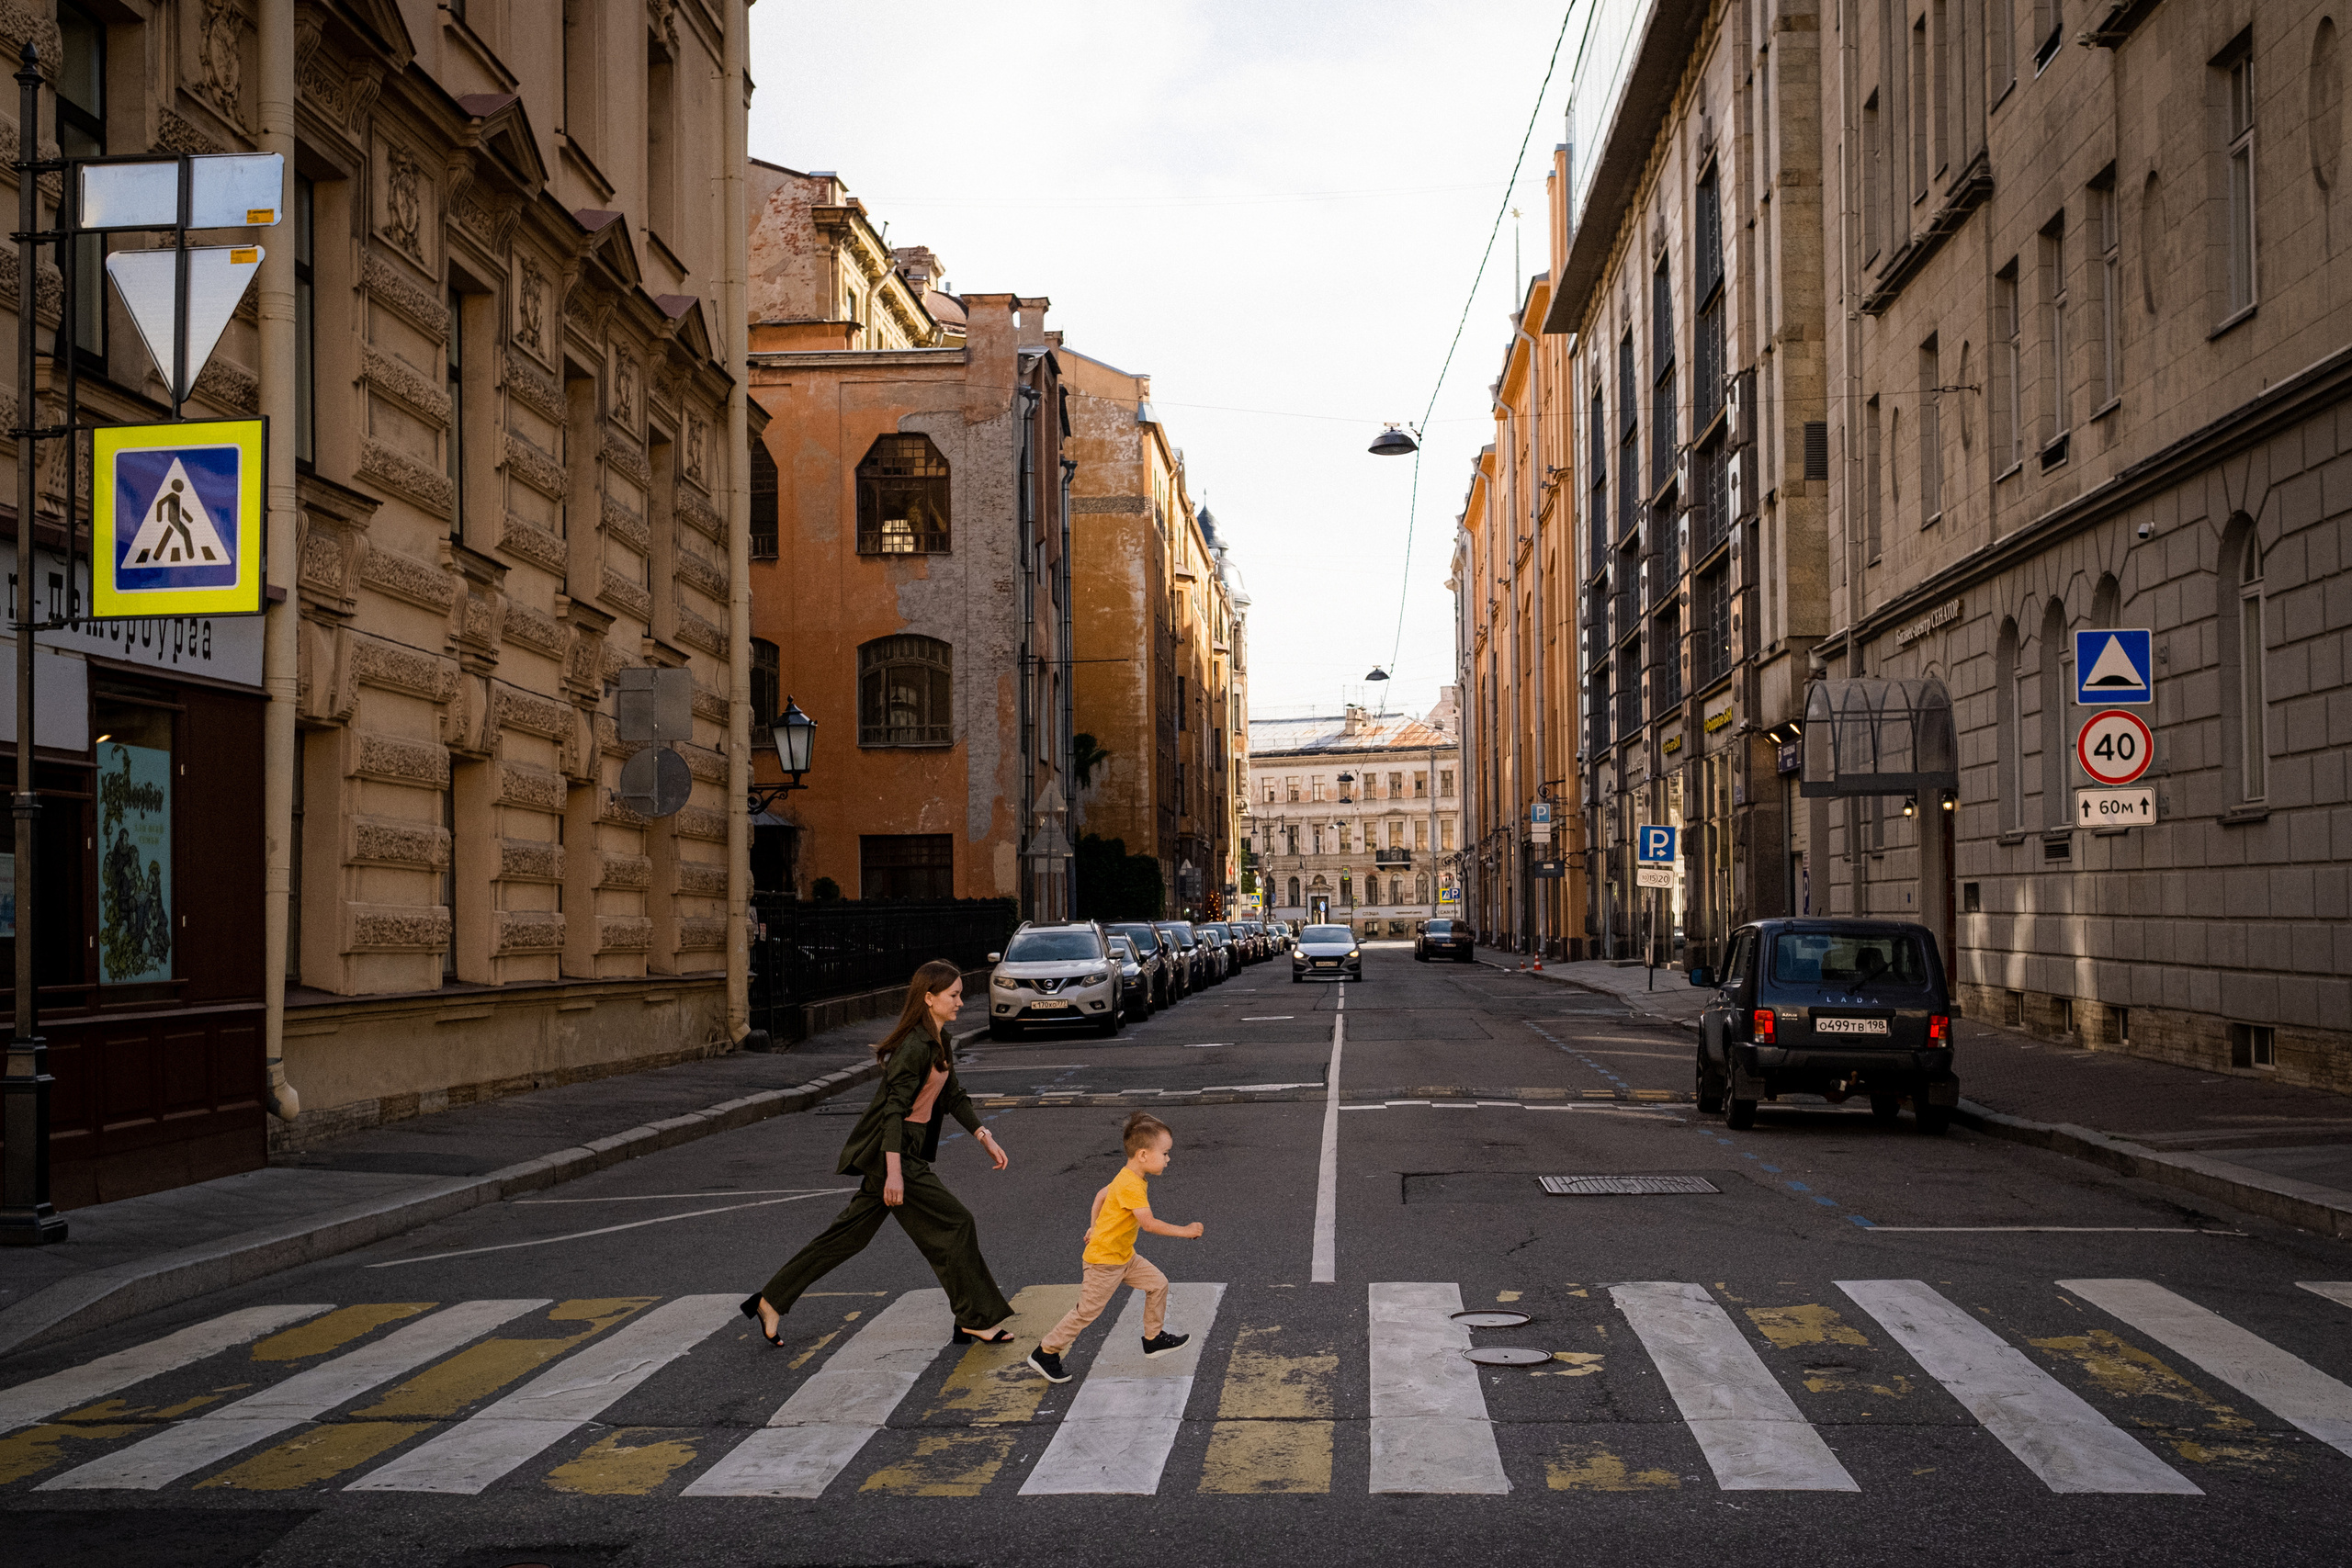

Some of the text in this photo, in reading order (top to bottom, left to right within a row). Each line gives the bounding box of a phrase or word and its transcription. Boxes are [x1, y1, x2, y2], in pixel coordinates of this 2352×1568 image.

[1930, 599, 1960, 628] СЕНАТОР
[2093, 733, 2135, 761] 40
[1536, 806, 1547, 821] P
[1648, 829, 1669, 858] P
[1657, 875, 1669, 884] 20
